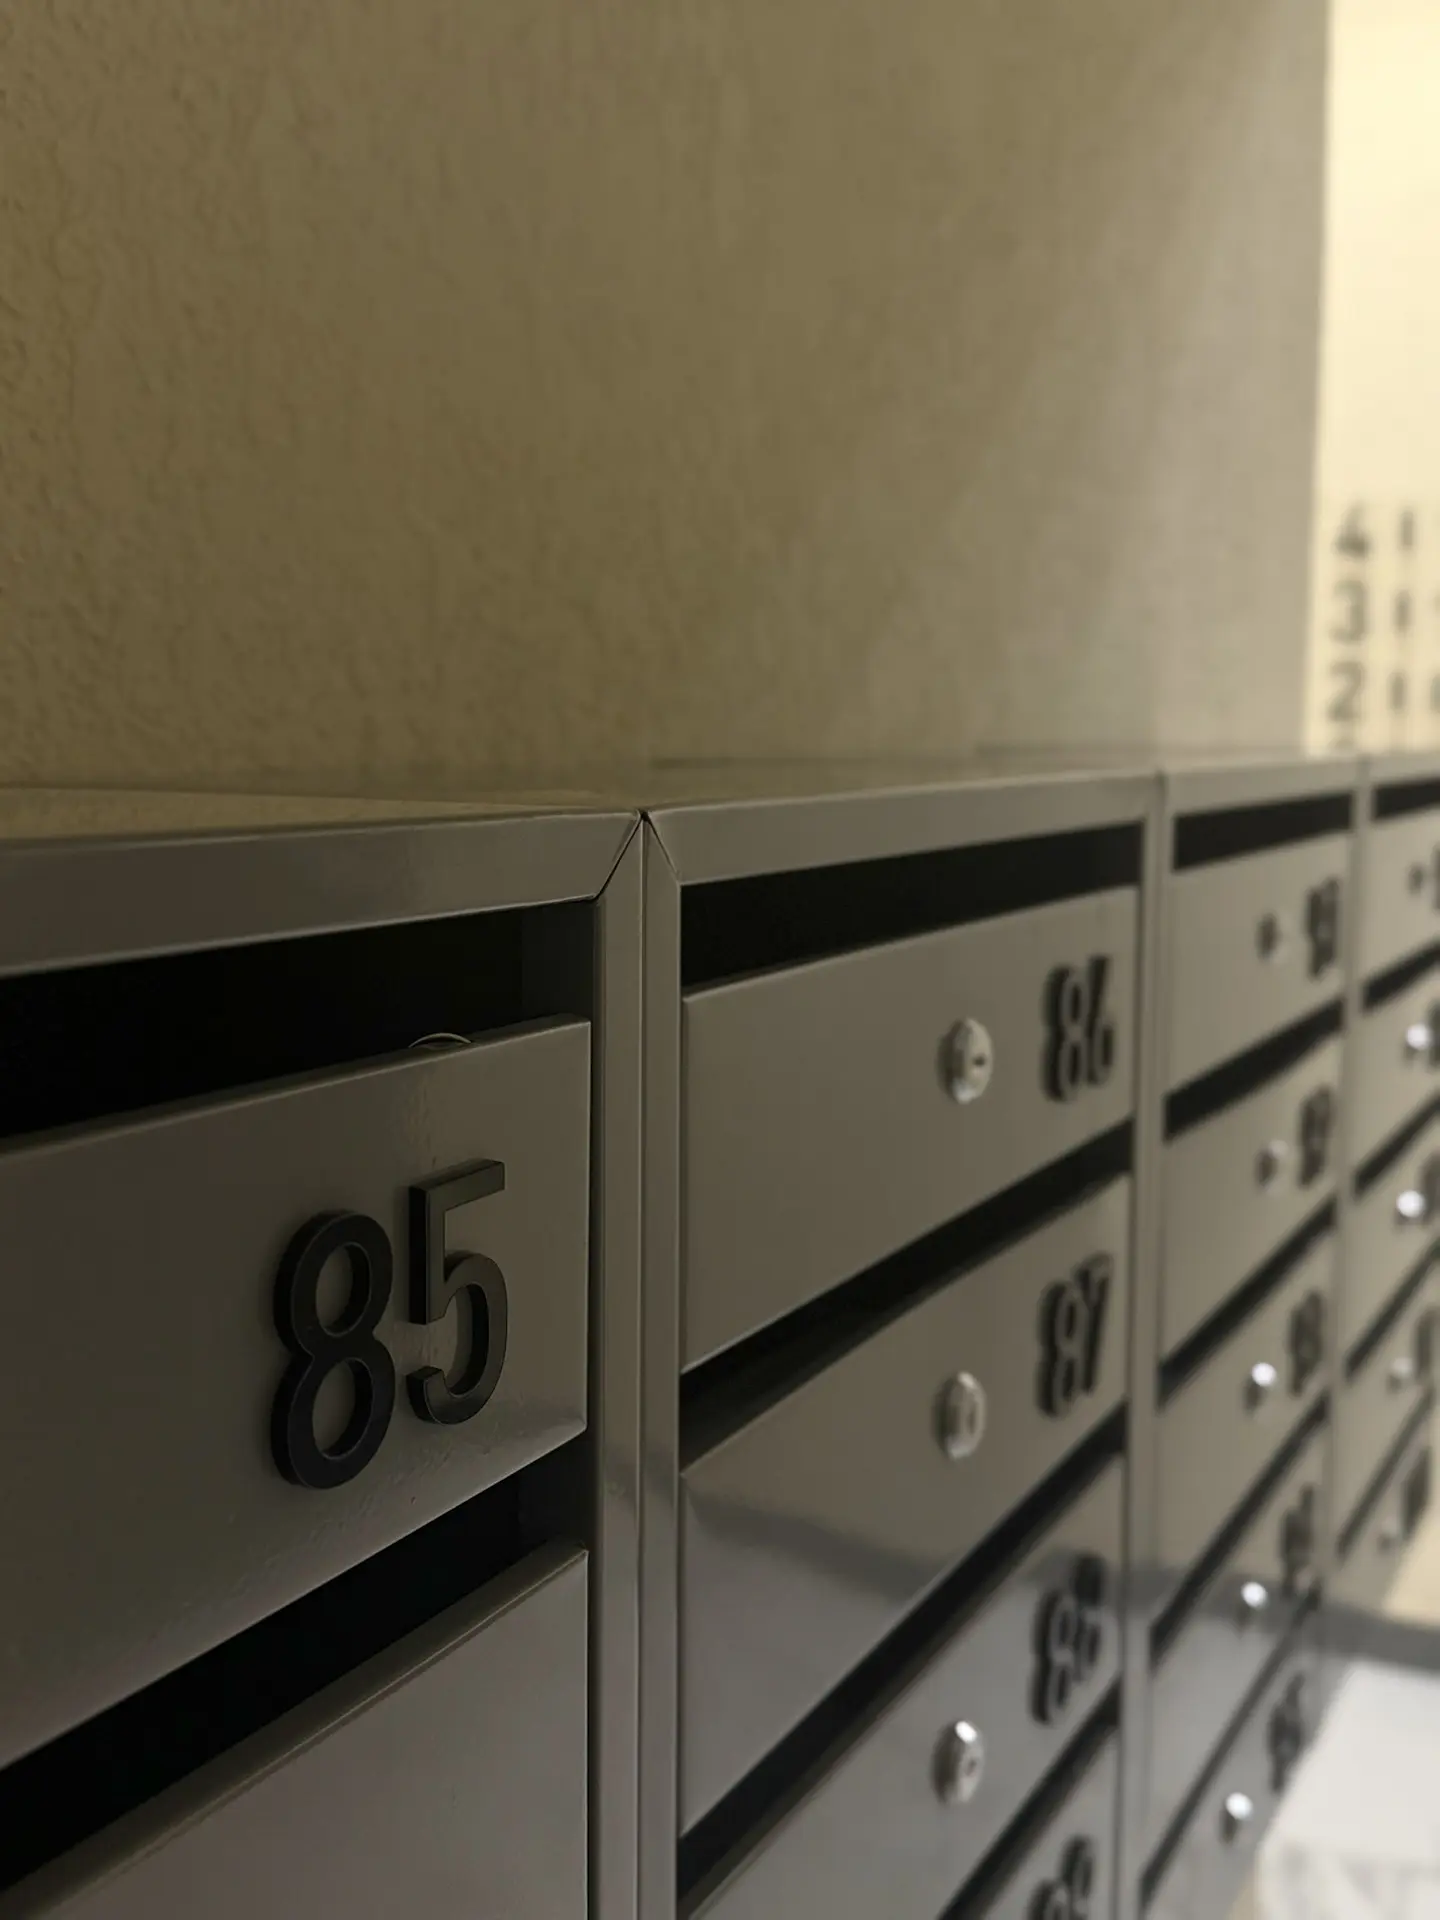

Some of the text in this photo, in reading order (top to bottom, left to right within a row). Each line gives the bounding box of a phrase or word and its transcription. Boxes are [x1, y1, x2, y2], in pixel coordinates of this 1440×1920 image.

[1330, 580, 1367, 642] 3
[1327, 660, 1364, 721] 2
[1043, 954, 1114, 1101] 86
[271, 1158, 507, 1489] 85
[1037, 1253, 1112, 1418] 87
